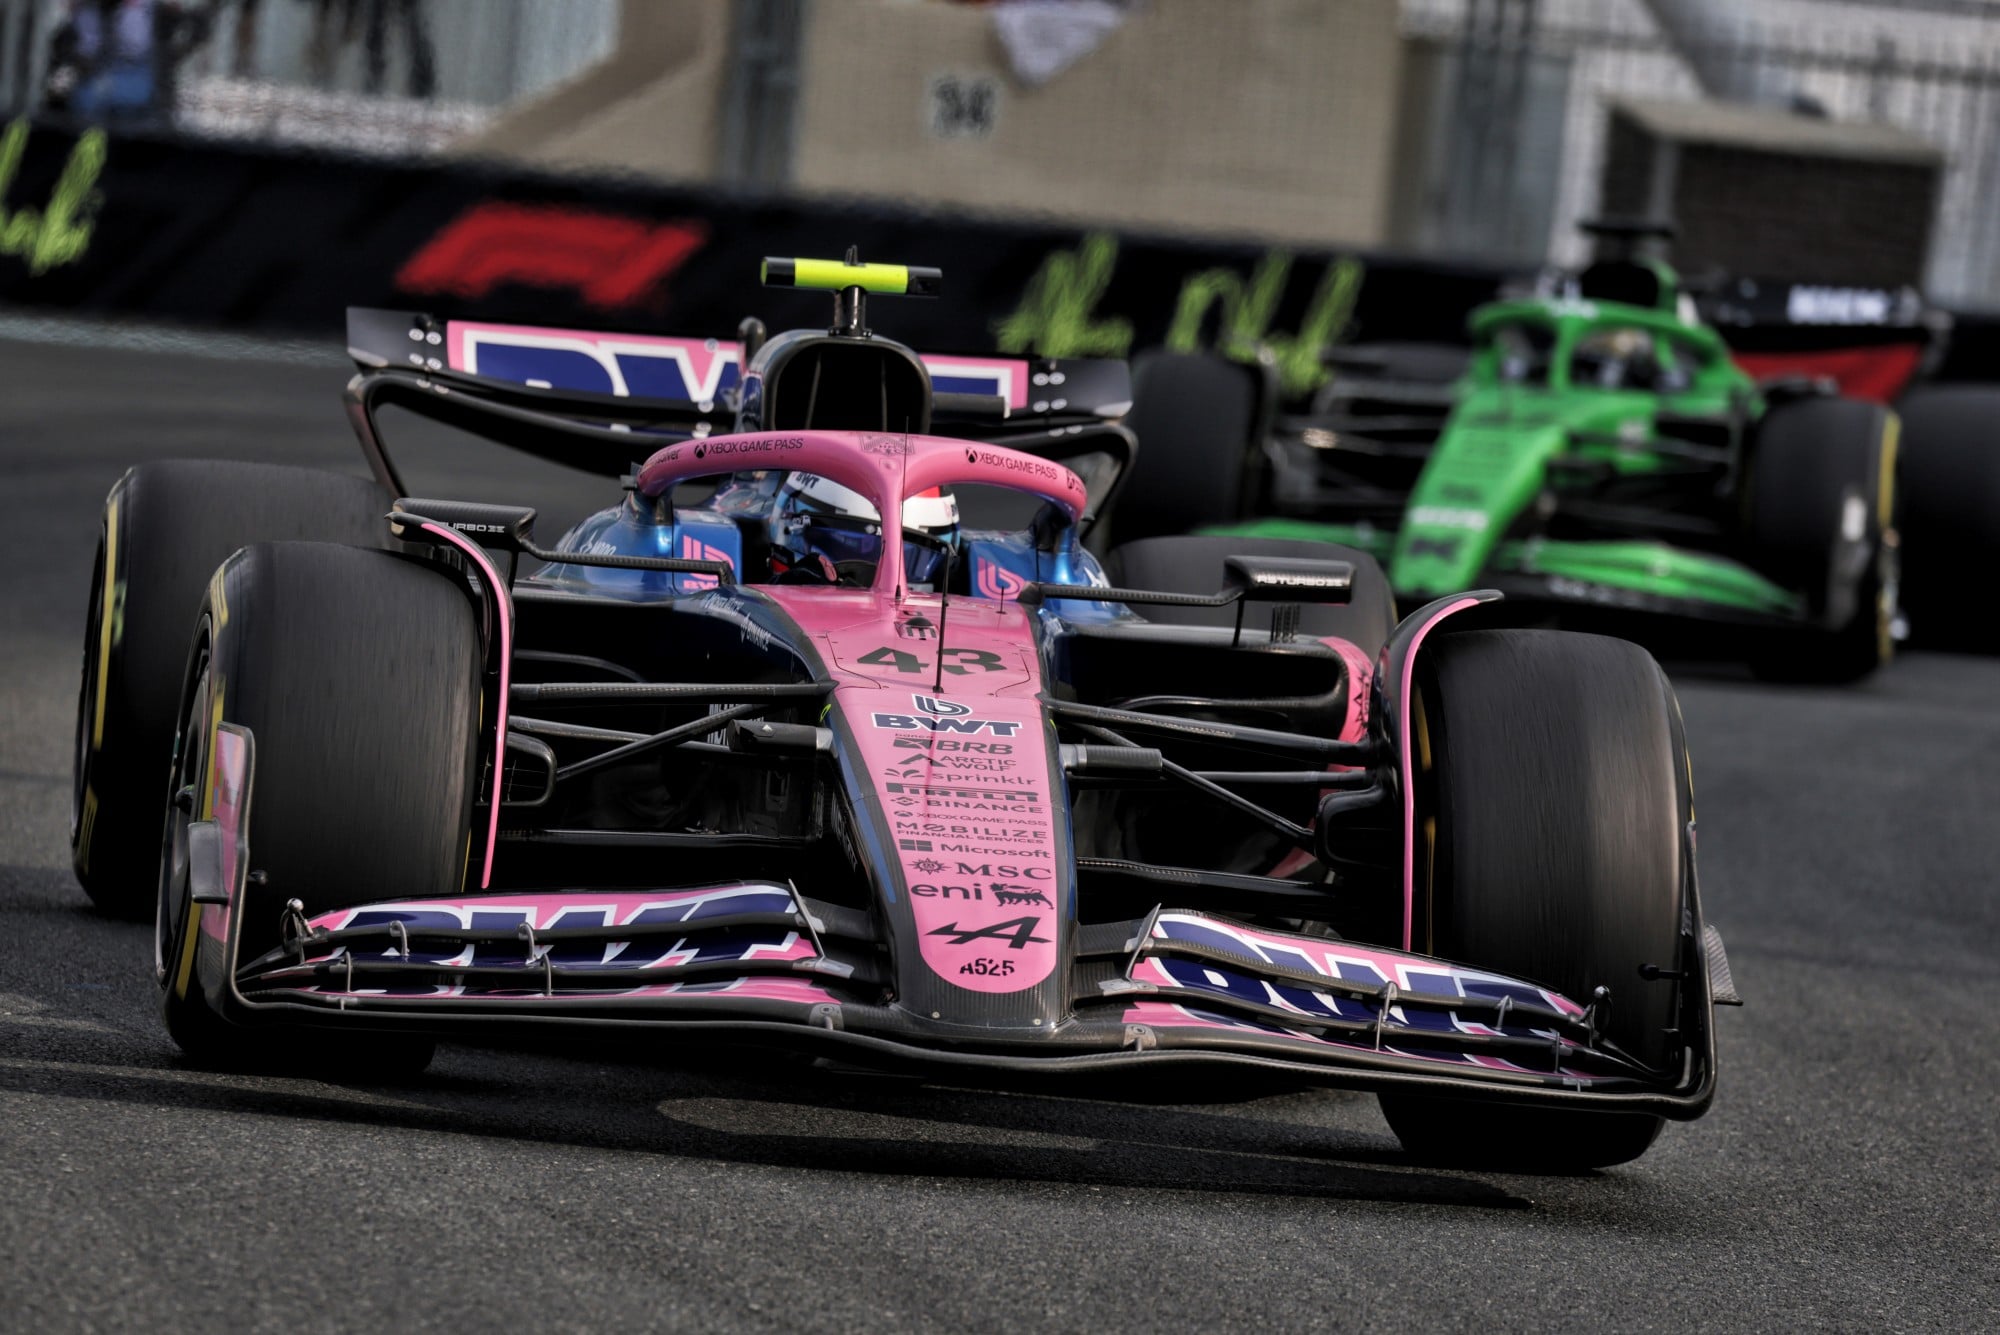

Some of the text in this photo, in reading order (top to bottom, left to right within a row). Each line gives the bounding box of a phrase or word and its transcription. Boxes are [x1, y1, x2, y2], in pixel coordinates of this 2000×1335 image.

[709, 438, 804, 455] XBOX GAME PASS
[980, 453, 1057, 480] XBOX GAME PASS
[857, 646, 1007, 676] 43
[871, 712, 1023, 737] BWT
[936, 739, 1013, 755] BRB
[940, 755, 1017, 766] ARCTIC
[951, 763, 1012, 772] WOLF
[932, 773, 1037, 785] sprinklr
[886, 782, 1039, 803] PIRELLI
[927, 800, 1043, 814] BINANCE
[917, 812, 1048, 826] XBOX GAME PASS
[897, 829, 1044, 844] FINANCIAL SERVICES
[940, 843, 1051, 859] Microsoft
[955, 862, 1052, 880] MSC
[911, 883, 982, 900] eni
[959, 958, 1015, 976] A525
